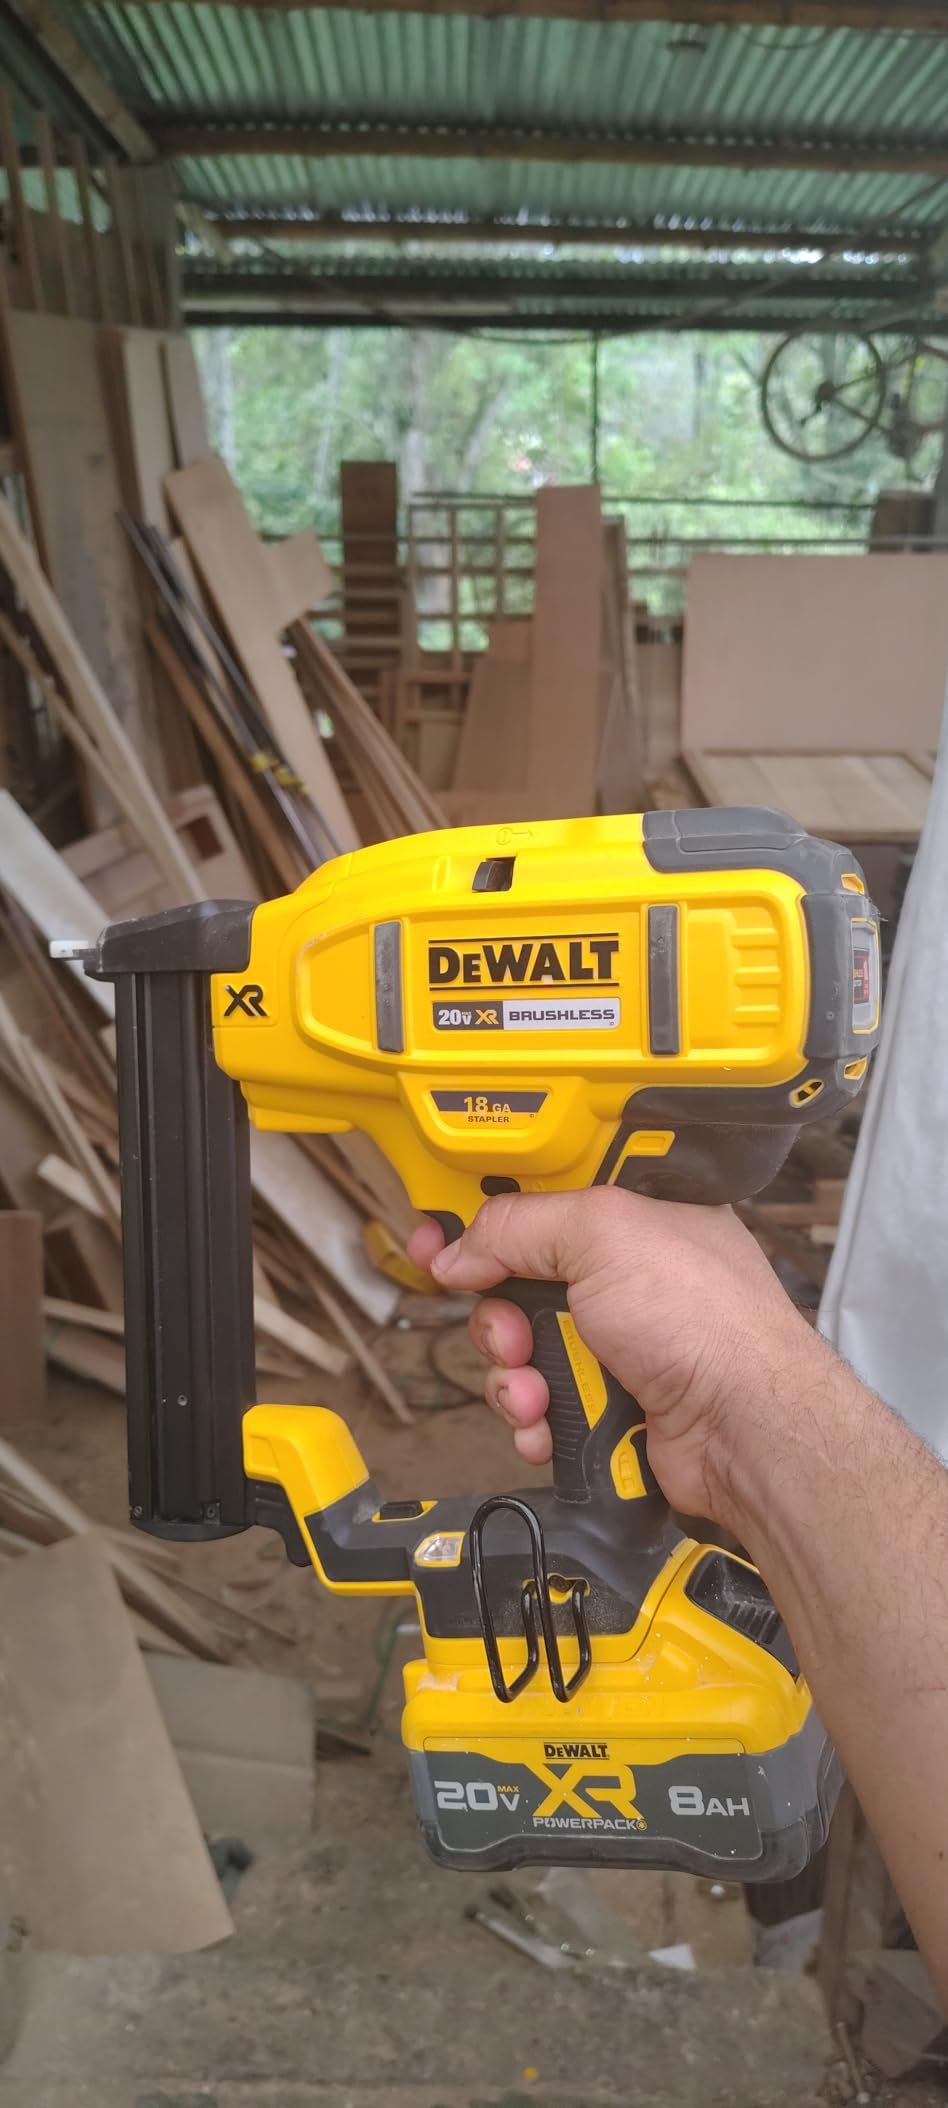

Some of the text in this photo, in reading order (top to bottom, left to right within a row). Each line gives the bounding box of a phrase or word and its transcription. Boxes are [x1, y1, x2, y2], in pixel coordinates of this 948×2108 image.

[428, 940, 620, 984] DEWALT
[223, 984, 267, 1017] XR
[475, 1009, 500, 1025] XR
[508, 1009, 615, 1022] BRUSHLESS
[463, 1096, 512, 1113] 18 GA
[467, 1115, 510, 1123] STAPLER
[543, 1744, 609, 1760] DEWALT
[497, 1785, 520, 1793] MAX
[523, 1763, 645, 1819] XR
[533, 1817, 638, 1830] POWERPACK
